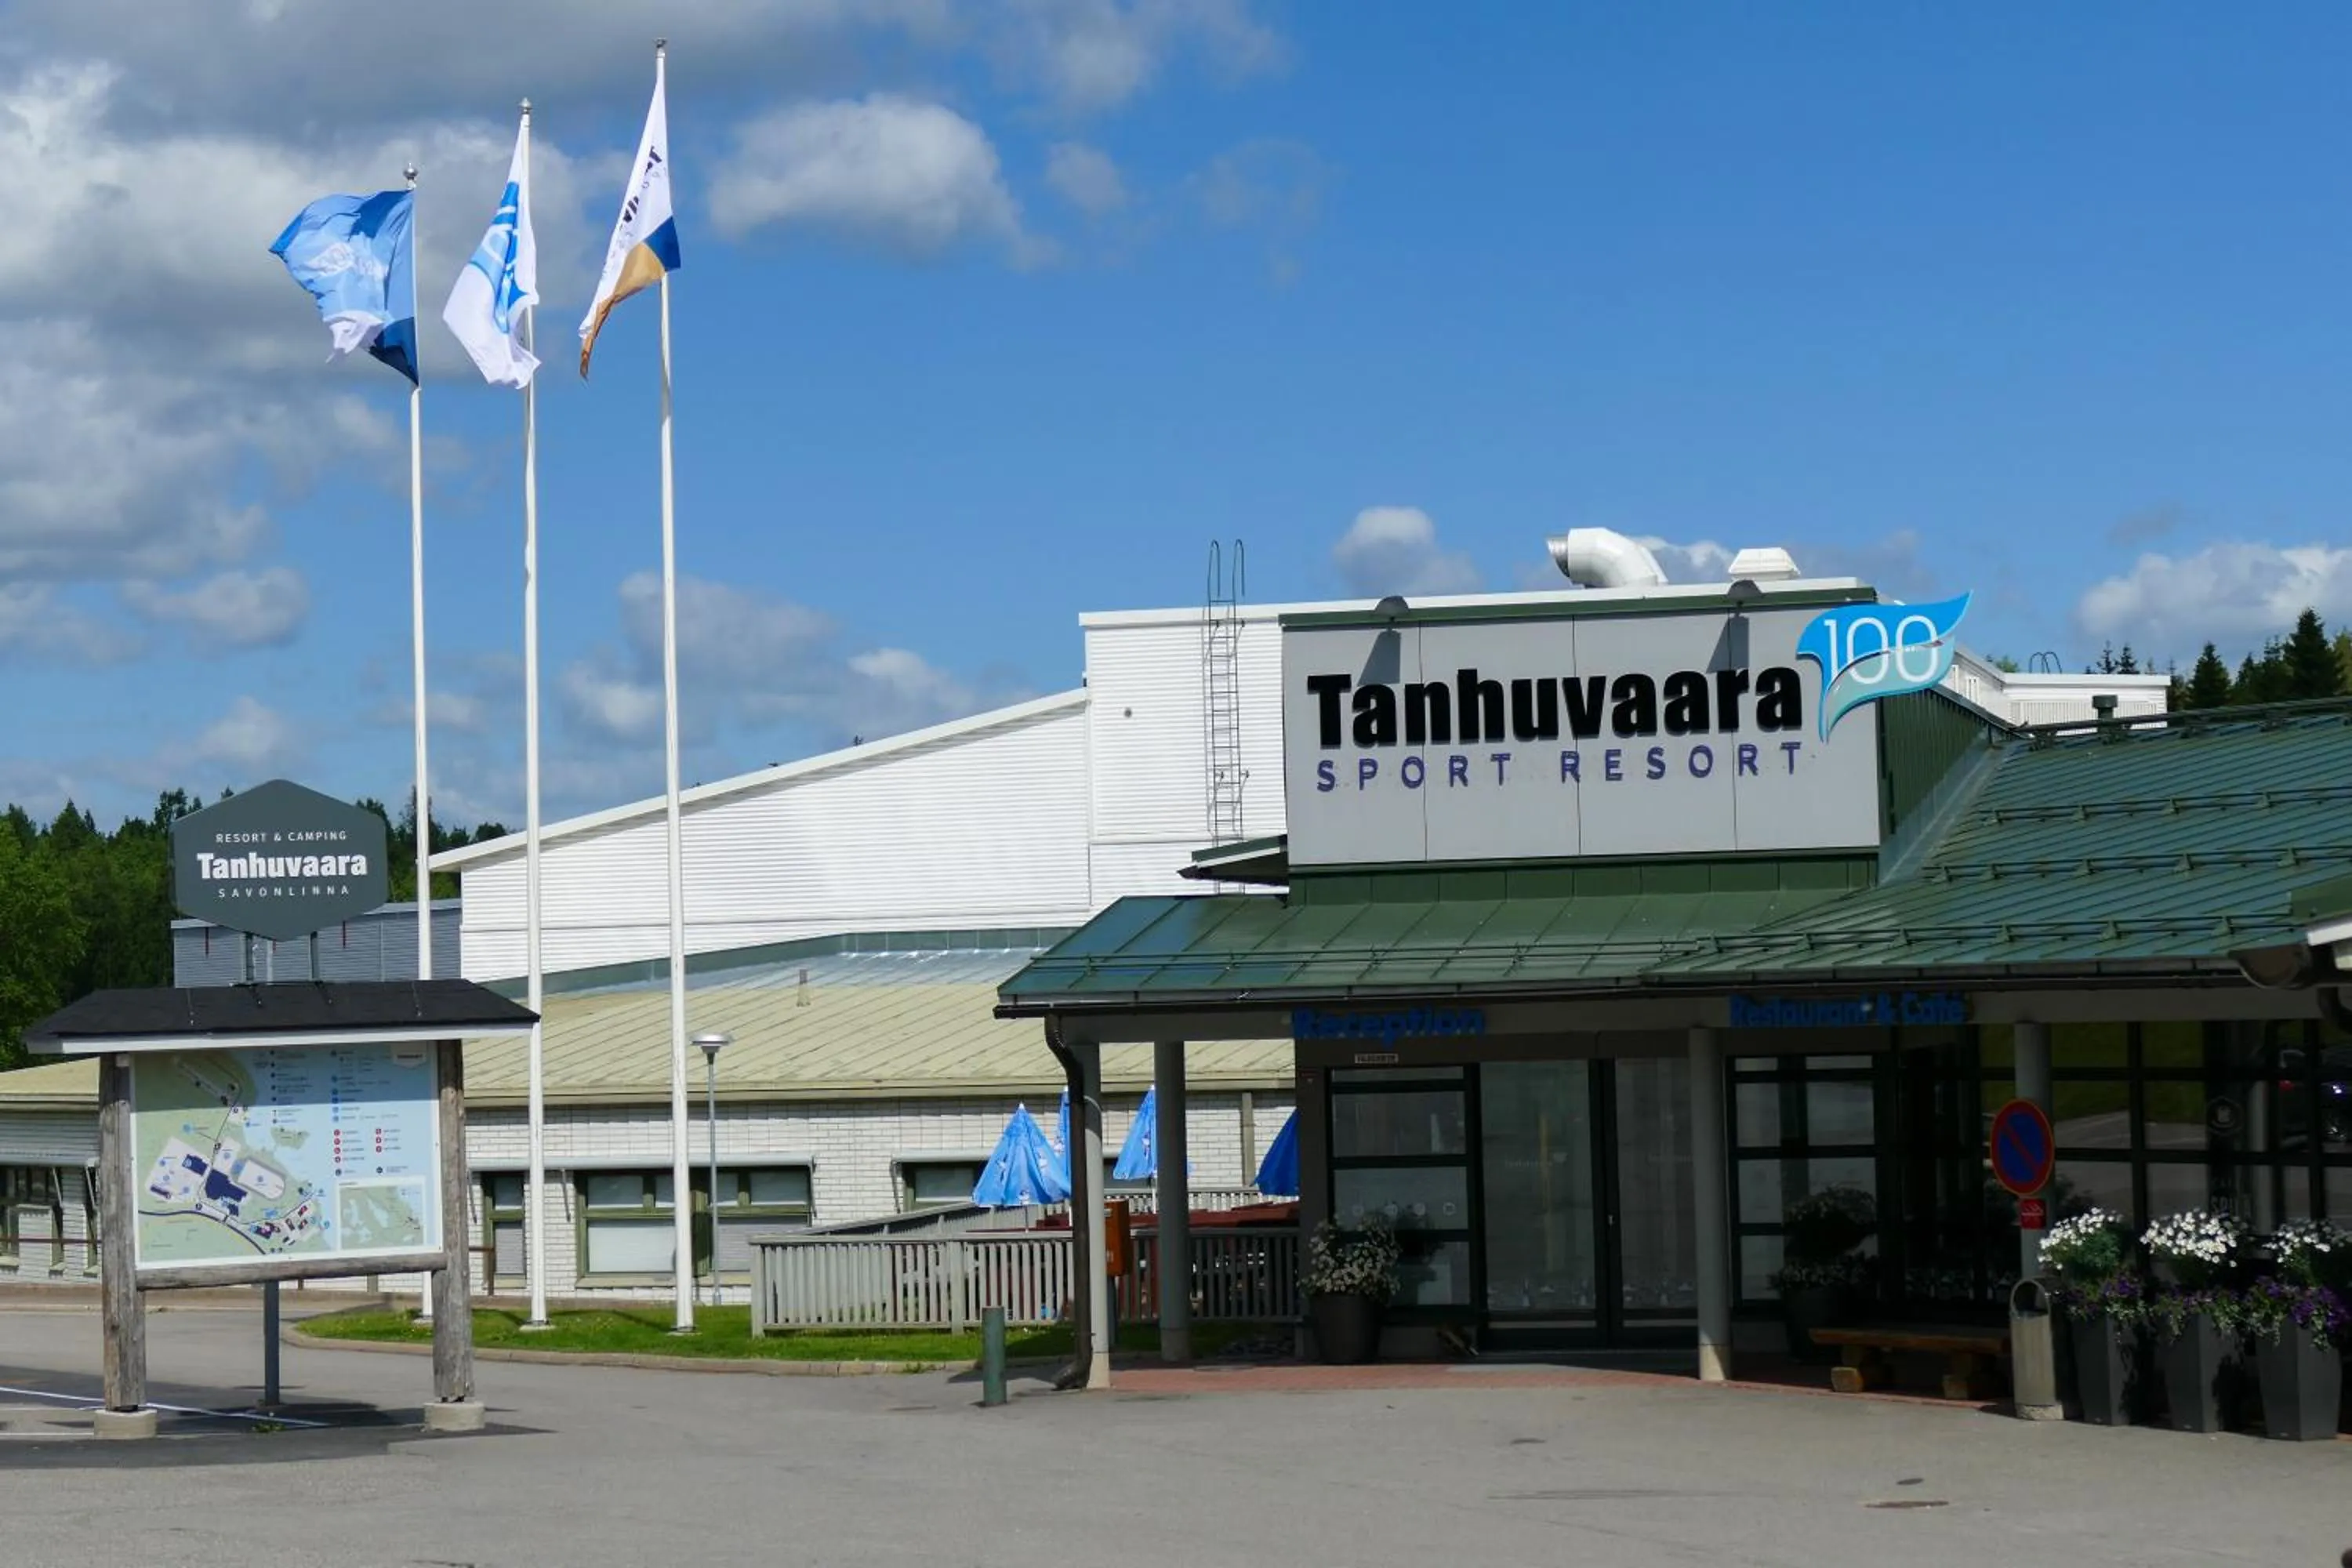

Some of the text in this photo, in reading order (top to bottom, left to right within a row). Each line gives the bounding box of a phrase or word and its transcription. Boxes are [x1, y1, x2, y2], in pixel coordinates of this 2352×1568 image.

[1824, 615, 1939, 684] 100
[1307, 667, 1803, 749] Tanhuvaara
[1316, 742, 1804, 793] SPORT RESORT
[216, 830, 347, 844] RESORT & CAMPING
[196, 851, 368, 880] Tanhuvaara
[218, 884, 350, 898] SAVONLINNA
[1294, 1006, 1484, 1047] Reception
